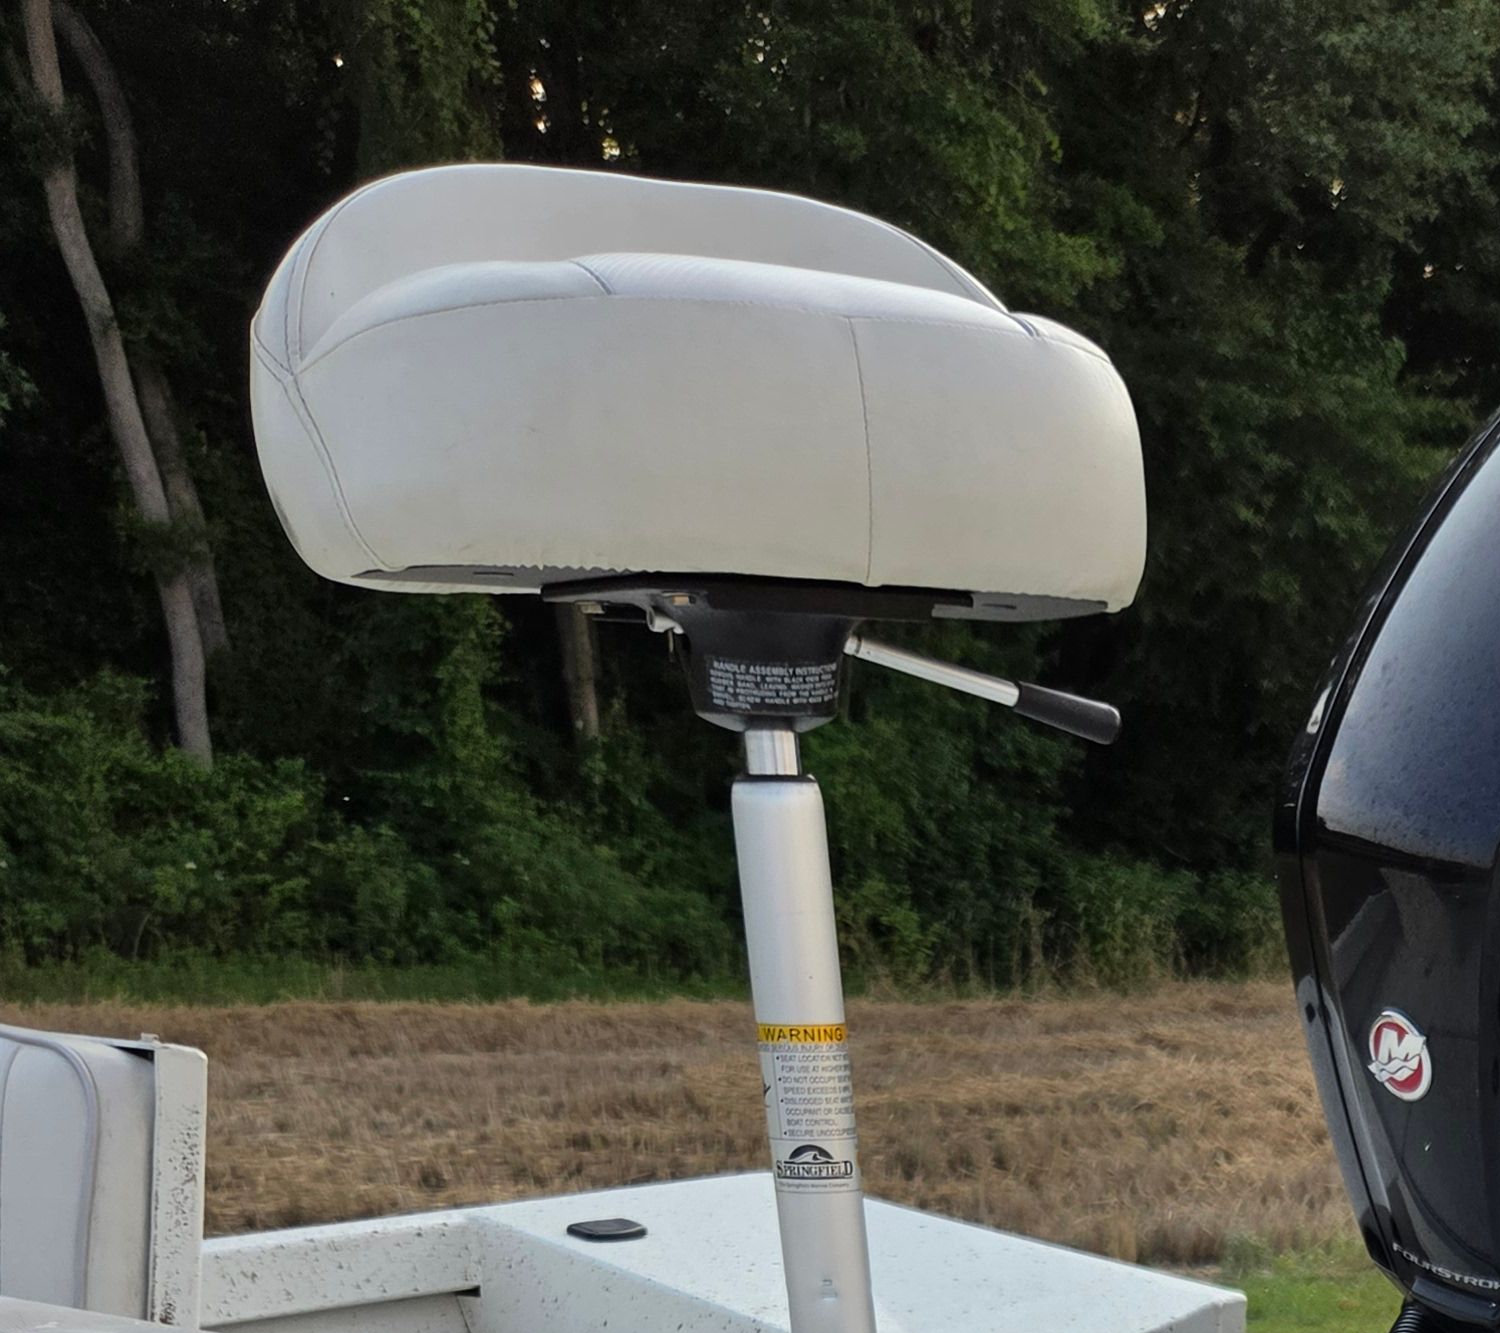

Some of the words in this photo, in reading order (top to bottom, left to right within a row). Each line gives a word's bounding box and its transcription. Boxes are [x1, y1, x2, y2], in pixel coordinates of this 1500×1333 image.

[749, 664, 794, 677] ASSEMBLY
[763, 1026, 844, 1042] WARNING
[798, 1054, 830, 1063] LOCATION
[781, 1065, 795, 1073] FOR
[796, 1065, 810, 1073] USE
[782, 1076, 793, 1084] DO
[793, 1076, 808, 1084] NOT
[809, 1075, 836, 1084] OCCUPY
[783, 1086, 806, 1095] SPEED
[785, 1107, 821, 1116] OCCUPANT
[786, 1118, 804, 1127] BOAT
[788, 1129, 815, 1138] SECURE
[775, 1159, 853, 1178] SPRINGFIELD
